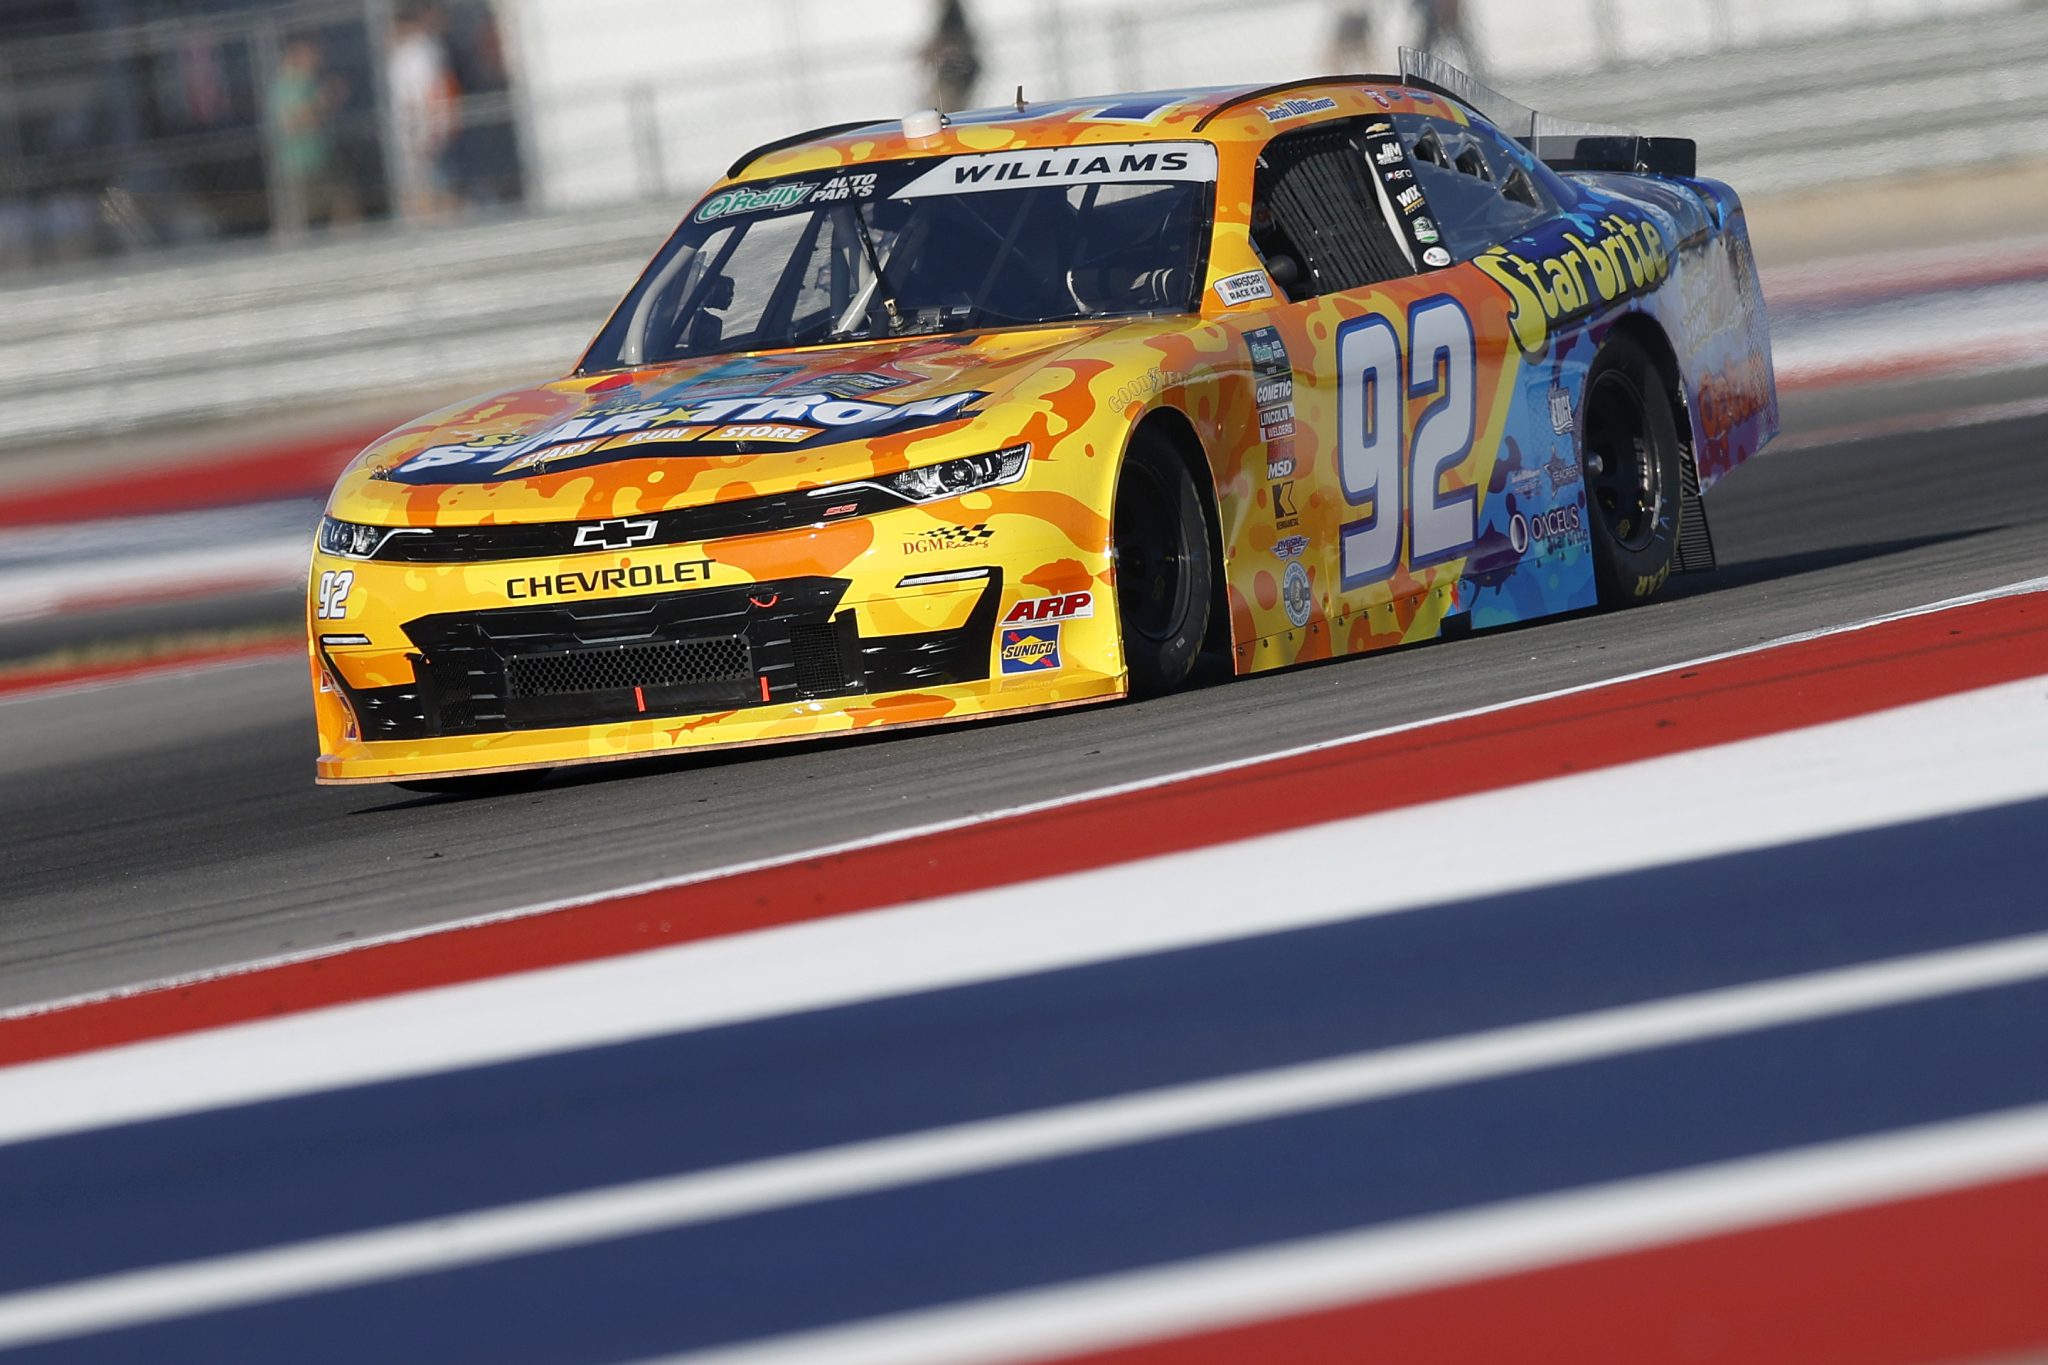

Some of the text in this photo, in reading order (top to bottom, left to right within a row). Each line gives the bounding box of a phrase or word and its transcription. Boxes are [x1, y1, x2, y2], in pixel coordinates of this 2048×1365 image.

[1261, 97, 1336, 121] Josh Williams
[954, 152, 1188, 184] WILLIAMS
[824, 173, 878, 190] AUTO
[698, 183, 813, 219] O'Reilly
[809, 184, 875, 203] PARTS
[1396, 184, 1422, 208] WIX
[1228, 285, 1266, 300] RACE CAR
[1231, 274, 1262, 289] NASCAR
[1256, 380, 1292, 403] COMETIC
[1260, 407, 1288, 426] LINCOLN
[1266, 424, 1292, 438] WELDERS
[1337, 292, 1478, 593] 92
[517, 440, 597, 468] START
[627, 428, 690, 444] RUN
[720, 426, 808, 441] STORE
[1267, 459, 1293, 480] MSD
[903, 537, 990, 555] DGM Racing
[506, 558, 717, 600] CHEVROLET
[318, 570, 354, 619] 92
[1003, 592, 1091, 622] ARP
[1004, 642, 1056, 659] SUNOCO
